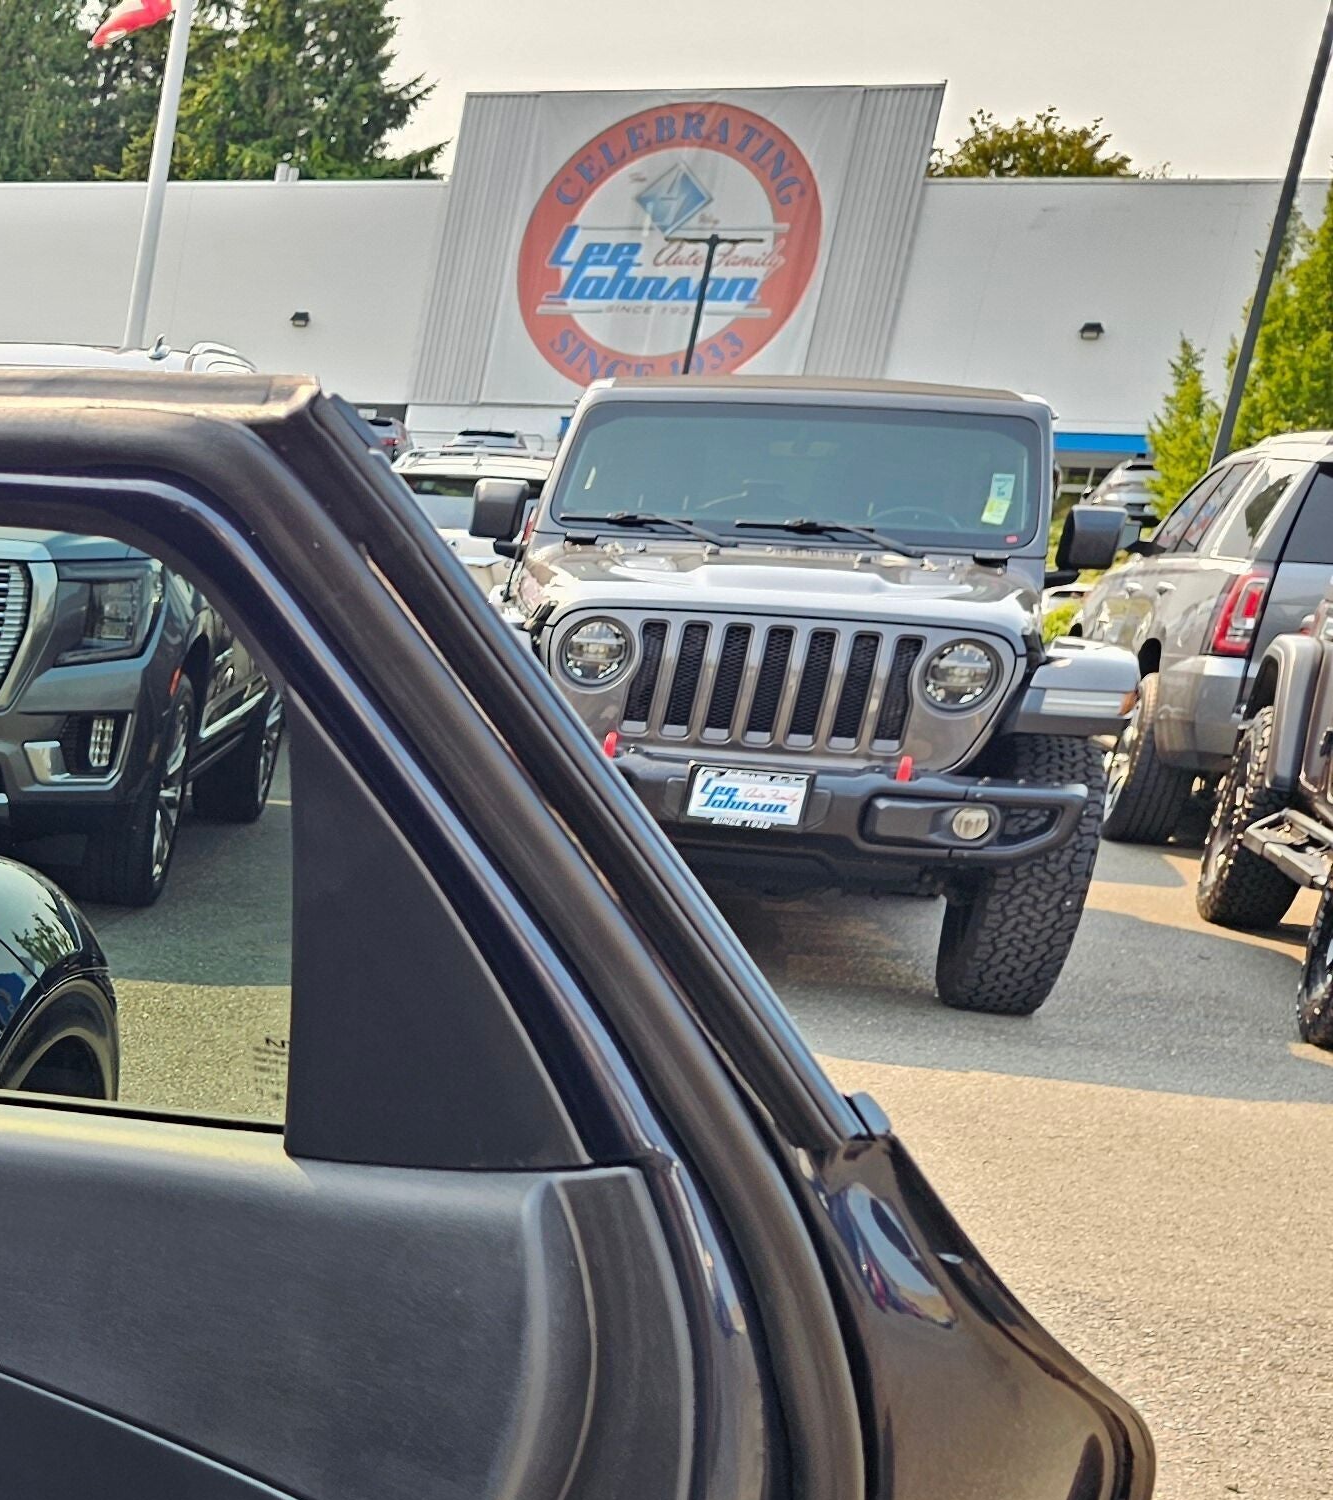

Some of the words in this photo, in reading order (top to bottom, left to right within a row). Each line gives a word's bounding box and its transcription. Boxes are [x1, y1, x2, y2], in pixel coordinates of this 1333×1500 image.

[555, 110, 806, 206] CELEBRATING
[546, 224, 642, 266] Lee
[652, 240, 704, 267] Auto
[710, 238, 786, 279] Family
[544, 262, 760, 301] Johnson
[605, 303, 654, 314] SINCE
[698, 793, 789, 814] Johnson
[699, 778, 739, 795] Lee
